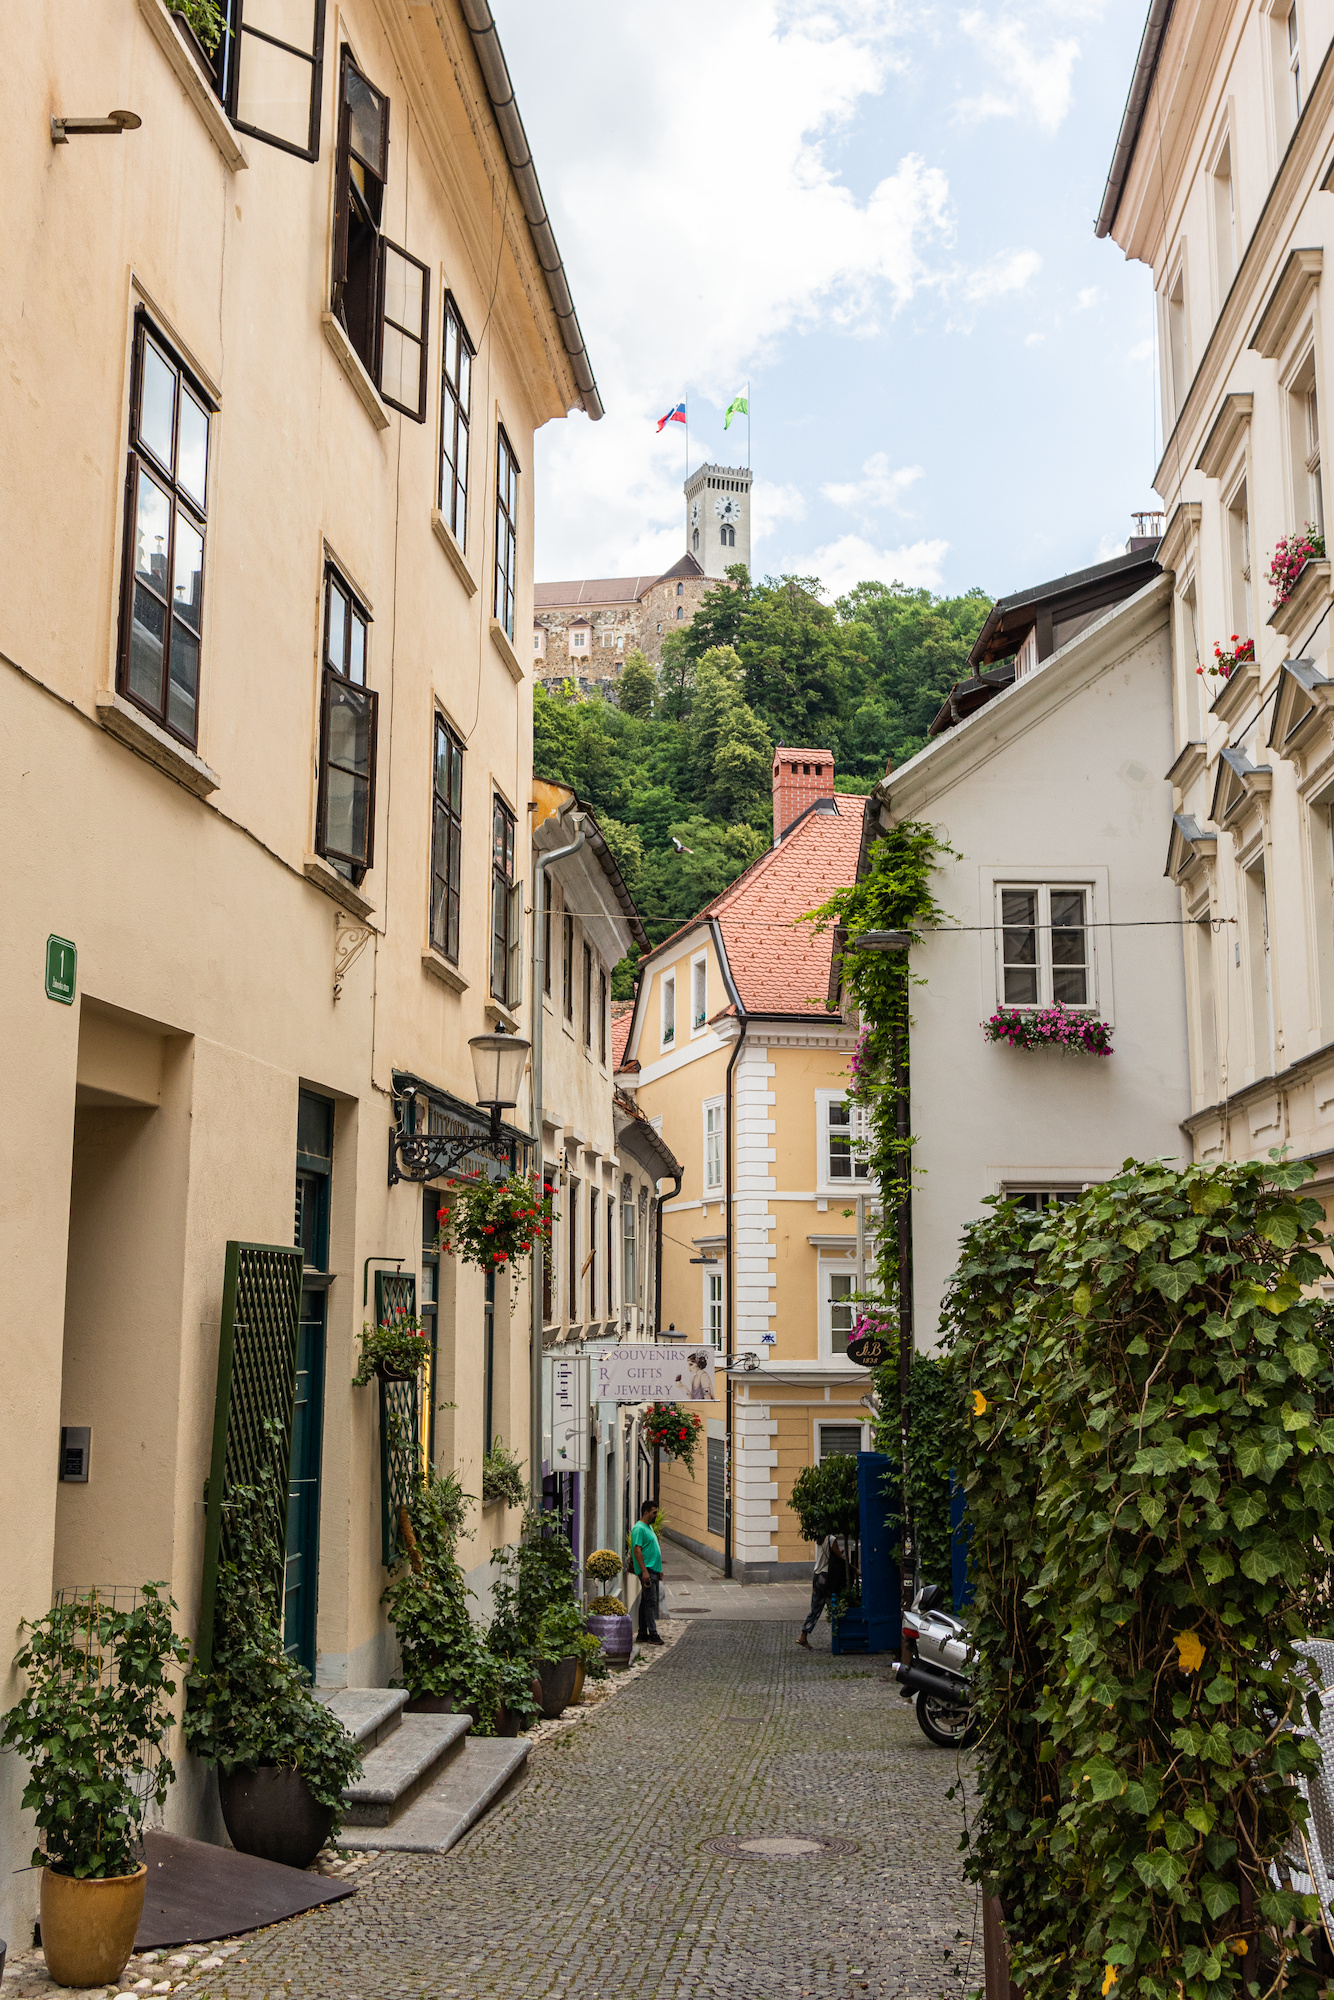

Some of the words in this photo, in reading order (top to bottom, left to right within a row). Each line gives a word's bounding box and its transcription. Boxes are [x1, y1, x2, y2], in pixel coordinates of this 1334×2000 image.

[60, 950, 64, 978] 1
[613, 1350, 686, 1360] SOUVENIRS
[627, 1368, 662, 1378] GIFTS
[555, 1363, 573, 1411] galerija
[614, 1385, 673, 1396] JEWELRY
